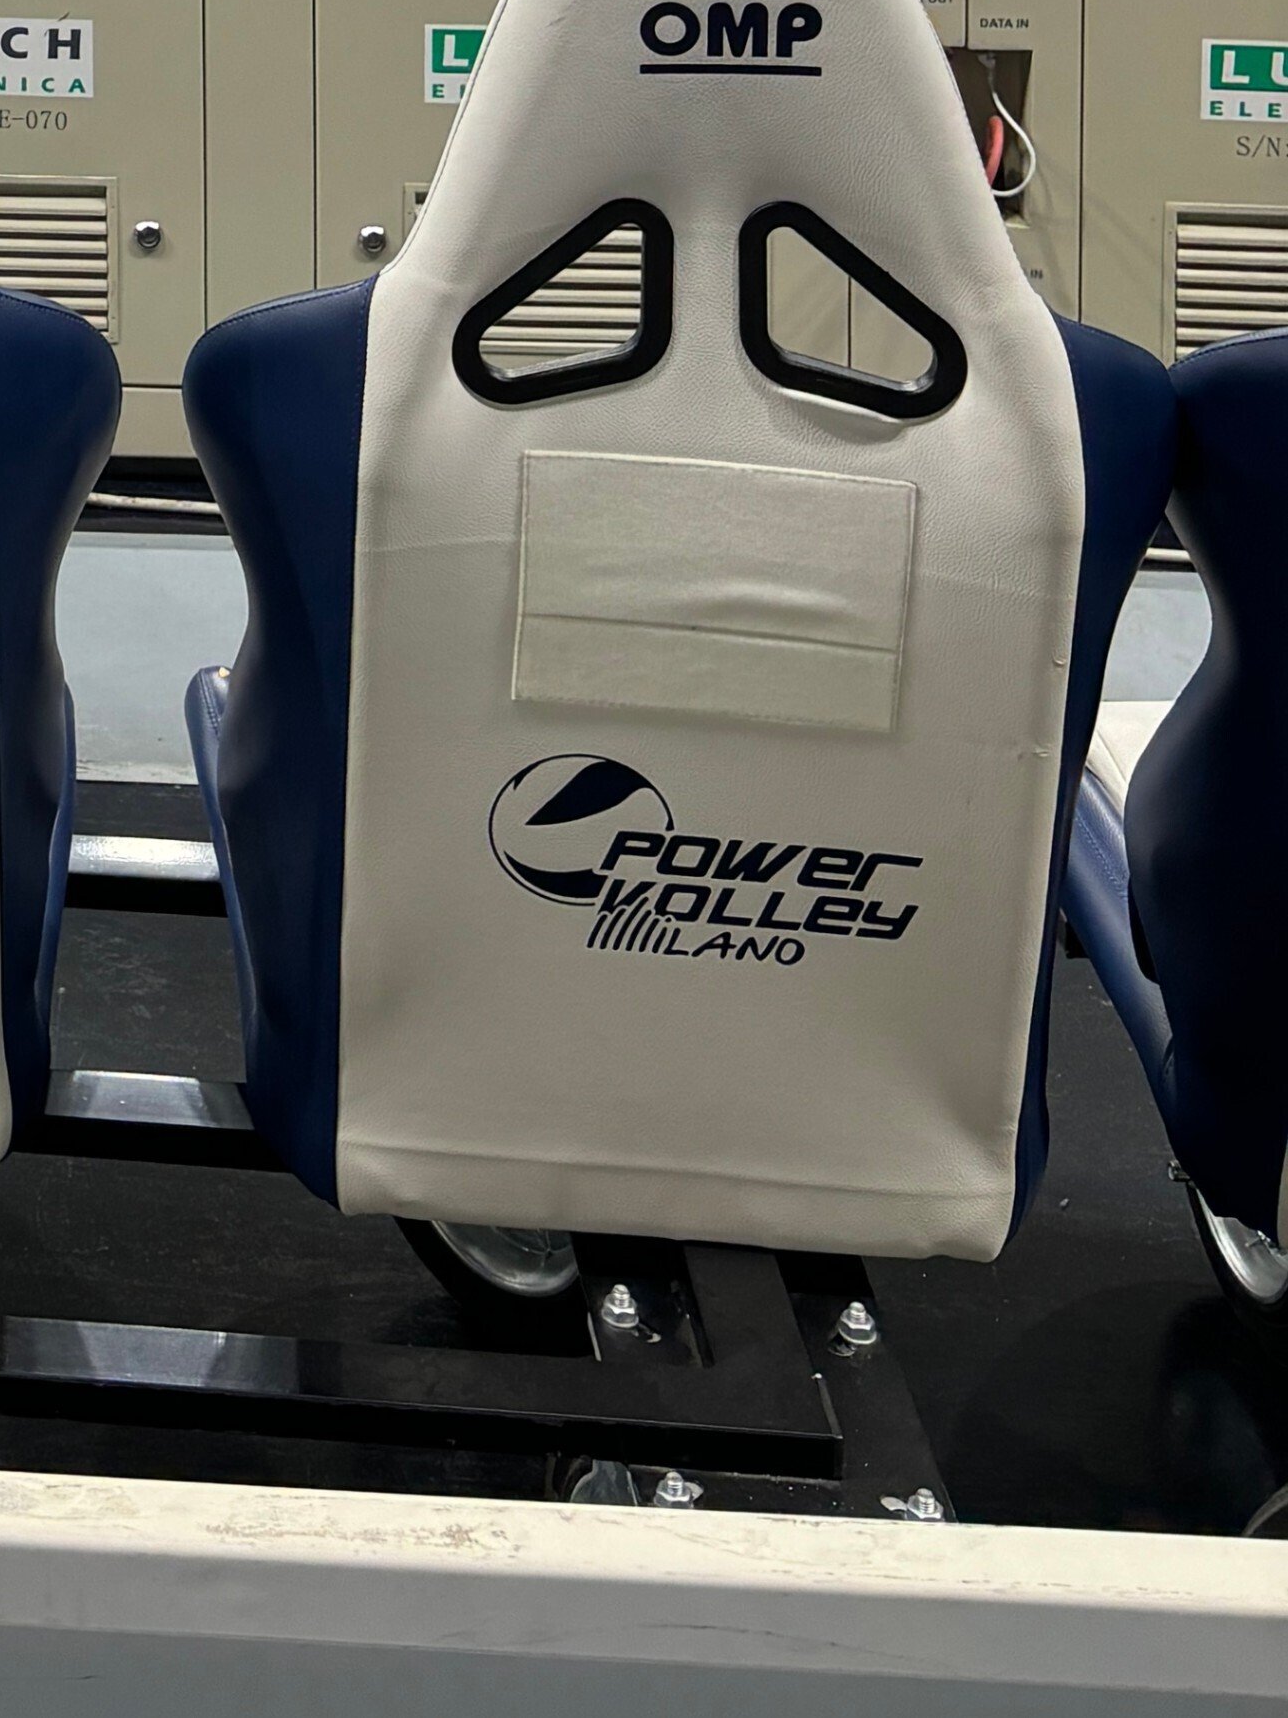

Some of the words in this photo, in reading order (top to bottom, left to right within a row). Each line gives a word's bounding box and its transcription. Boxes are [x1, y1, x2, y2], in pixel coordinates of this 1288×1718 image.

[639, 0, 823, 60] OMP
[979, 17, 1014, 29] DATA
[1016, 18, 1029, 29] IN
[1209, 100, 1282, 119] ELE
